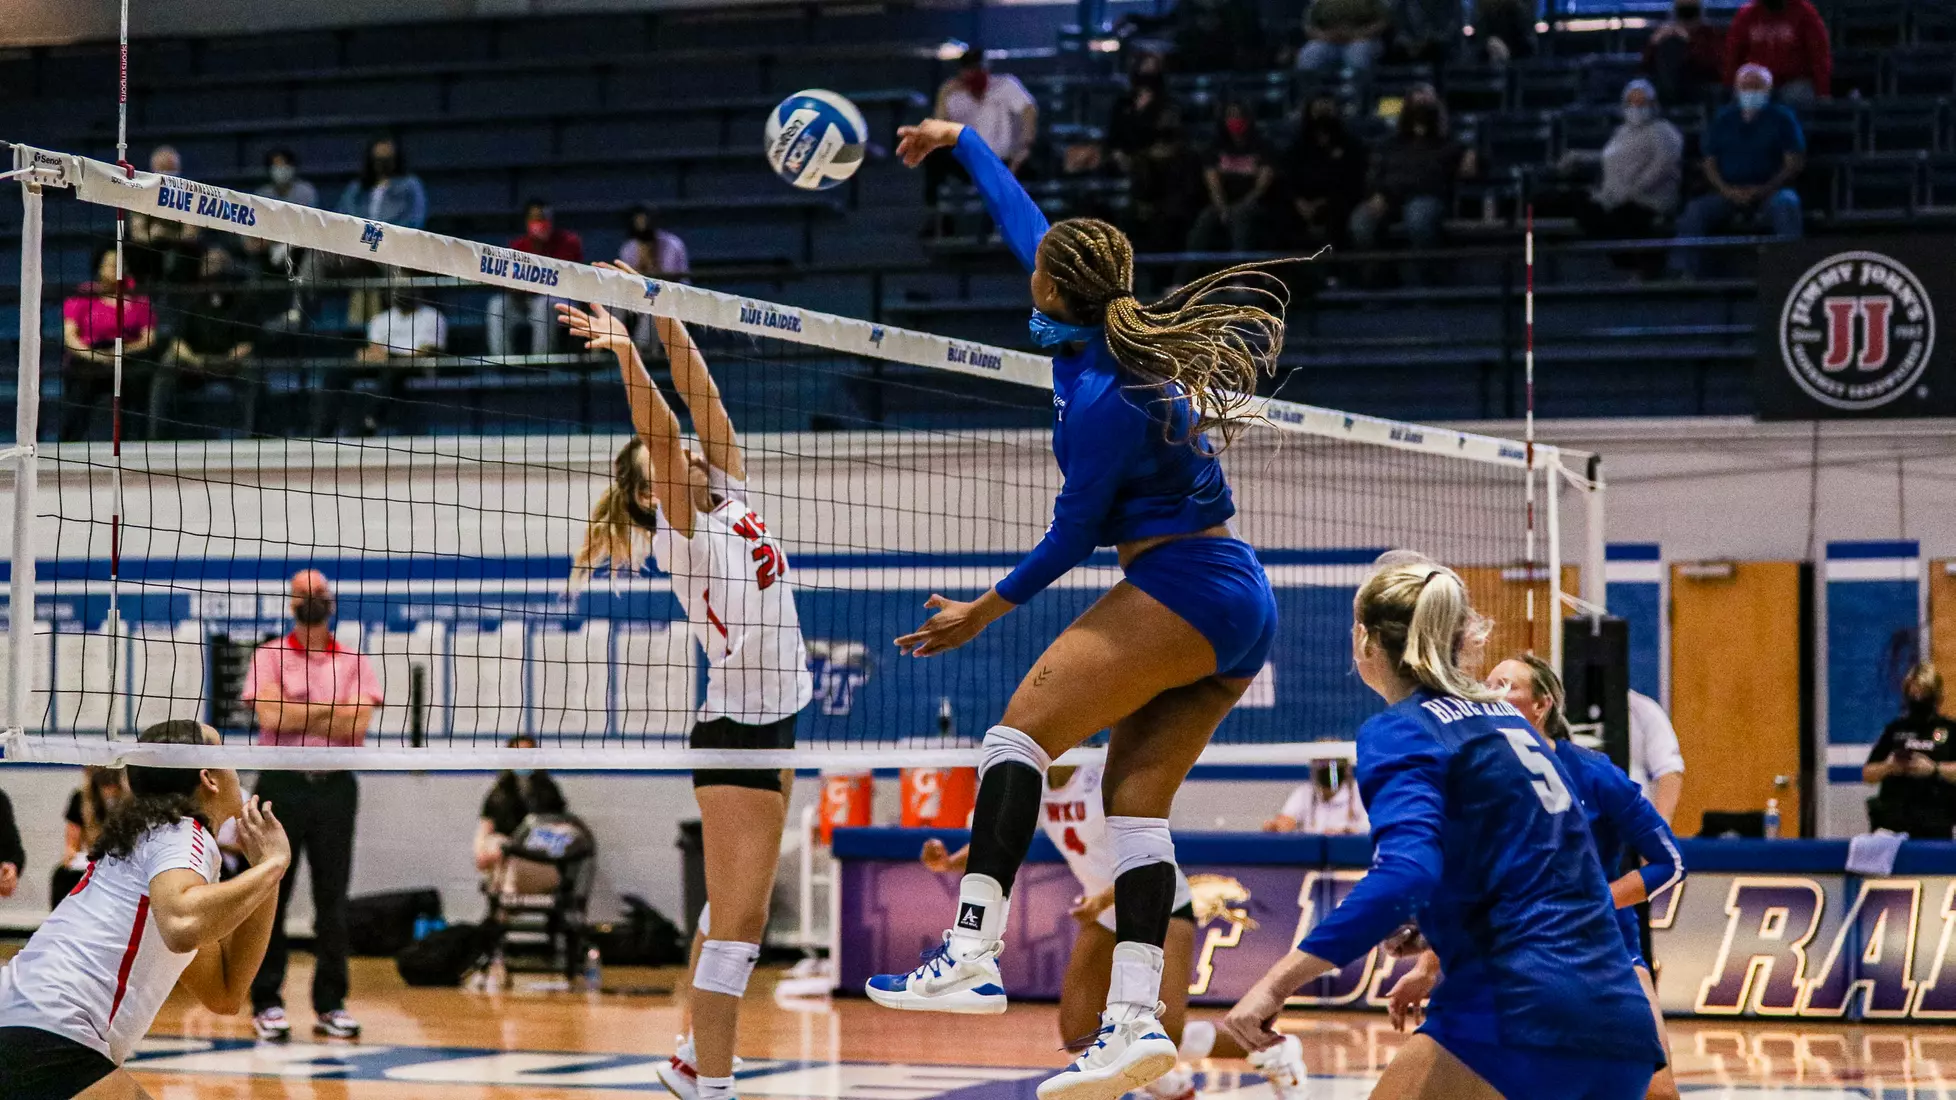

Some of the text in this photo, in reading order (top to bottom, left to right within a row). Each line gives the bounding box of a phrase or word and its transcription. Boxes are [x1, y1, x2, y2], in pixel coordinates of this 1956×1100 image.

[157, 187, 256, 226] BLUE RAIDERS
[480, 256, 559, 286] BLUE RAIDERS
[1791, 263, 1853, 326] JIMMY
[740, 307, 802, 332] BLUE RAIDERS
[1822, 296, 1894, 372] JJ
[1496, 728, 1572, 815] 5
[1046, 801, 1086, 822] WKU
[1064, 826, 1086, 856] 4
